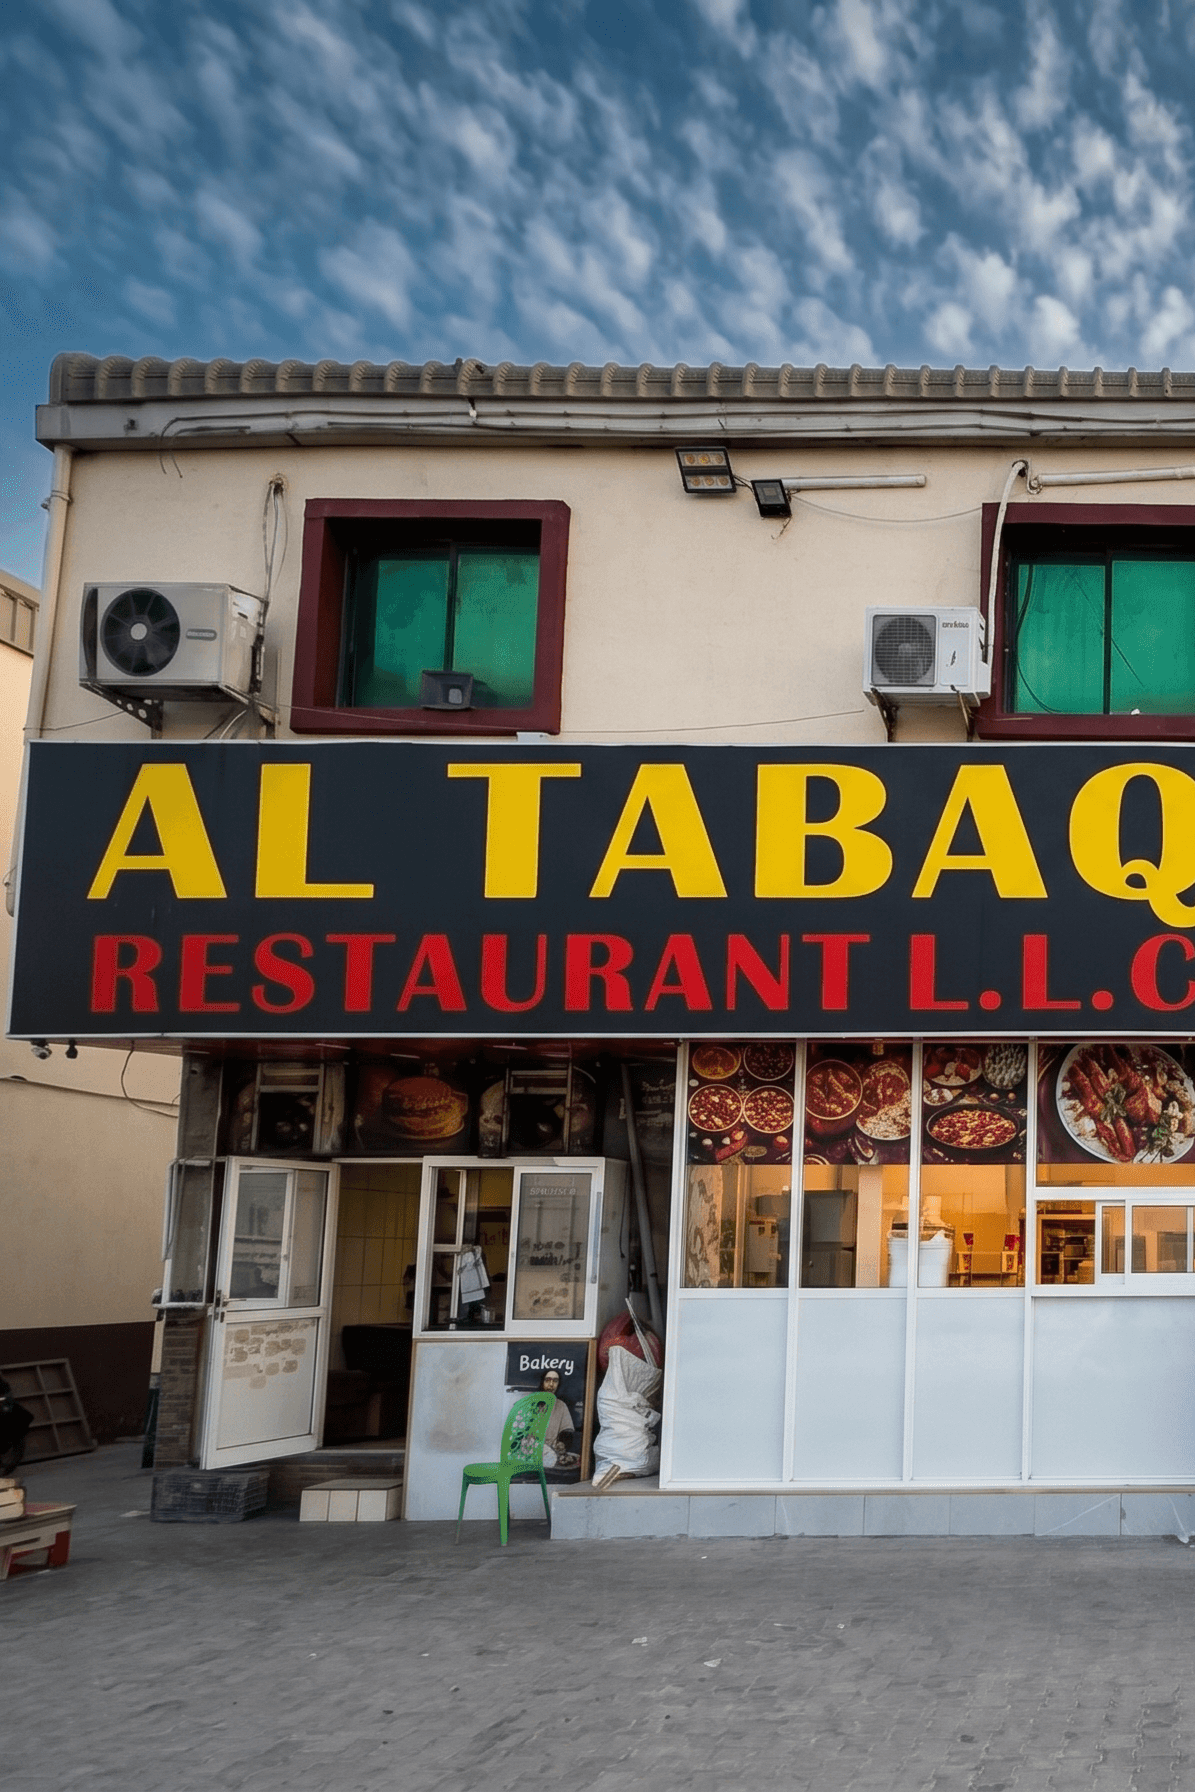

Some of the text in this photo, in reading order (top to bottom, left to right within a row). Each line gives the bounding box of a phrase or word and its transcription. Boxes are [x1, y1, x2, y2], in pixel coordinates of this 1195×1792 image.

[87, 763, 375, 900] AL
[90, 933, 871, 1014] RESTAURANT
[519, 1354, 574, 1376] Bakery
